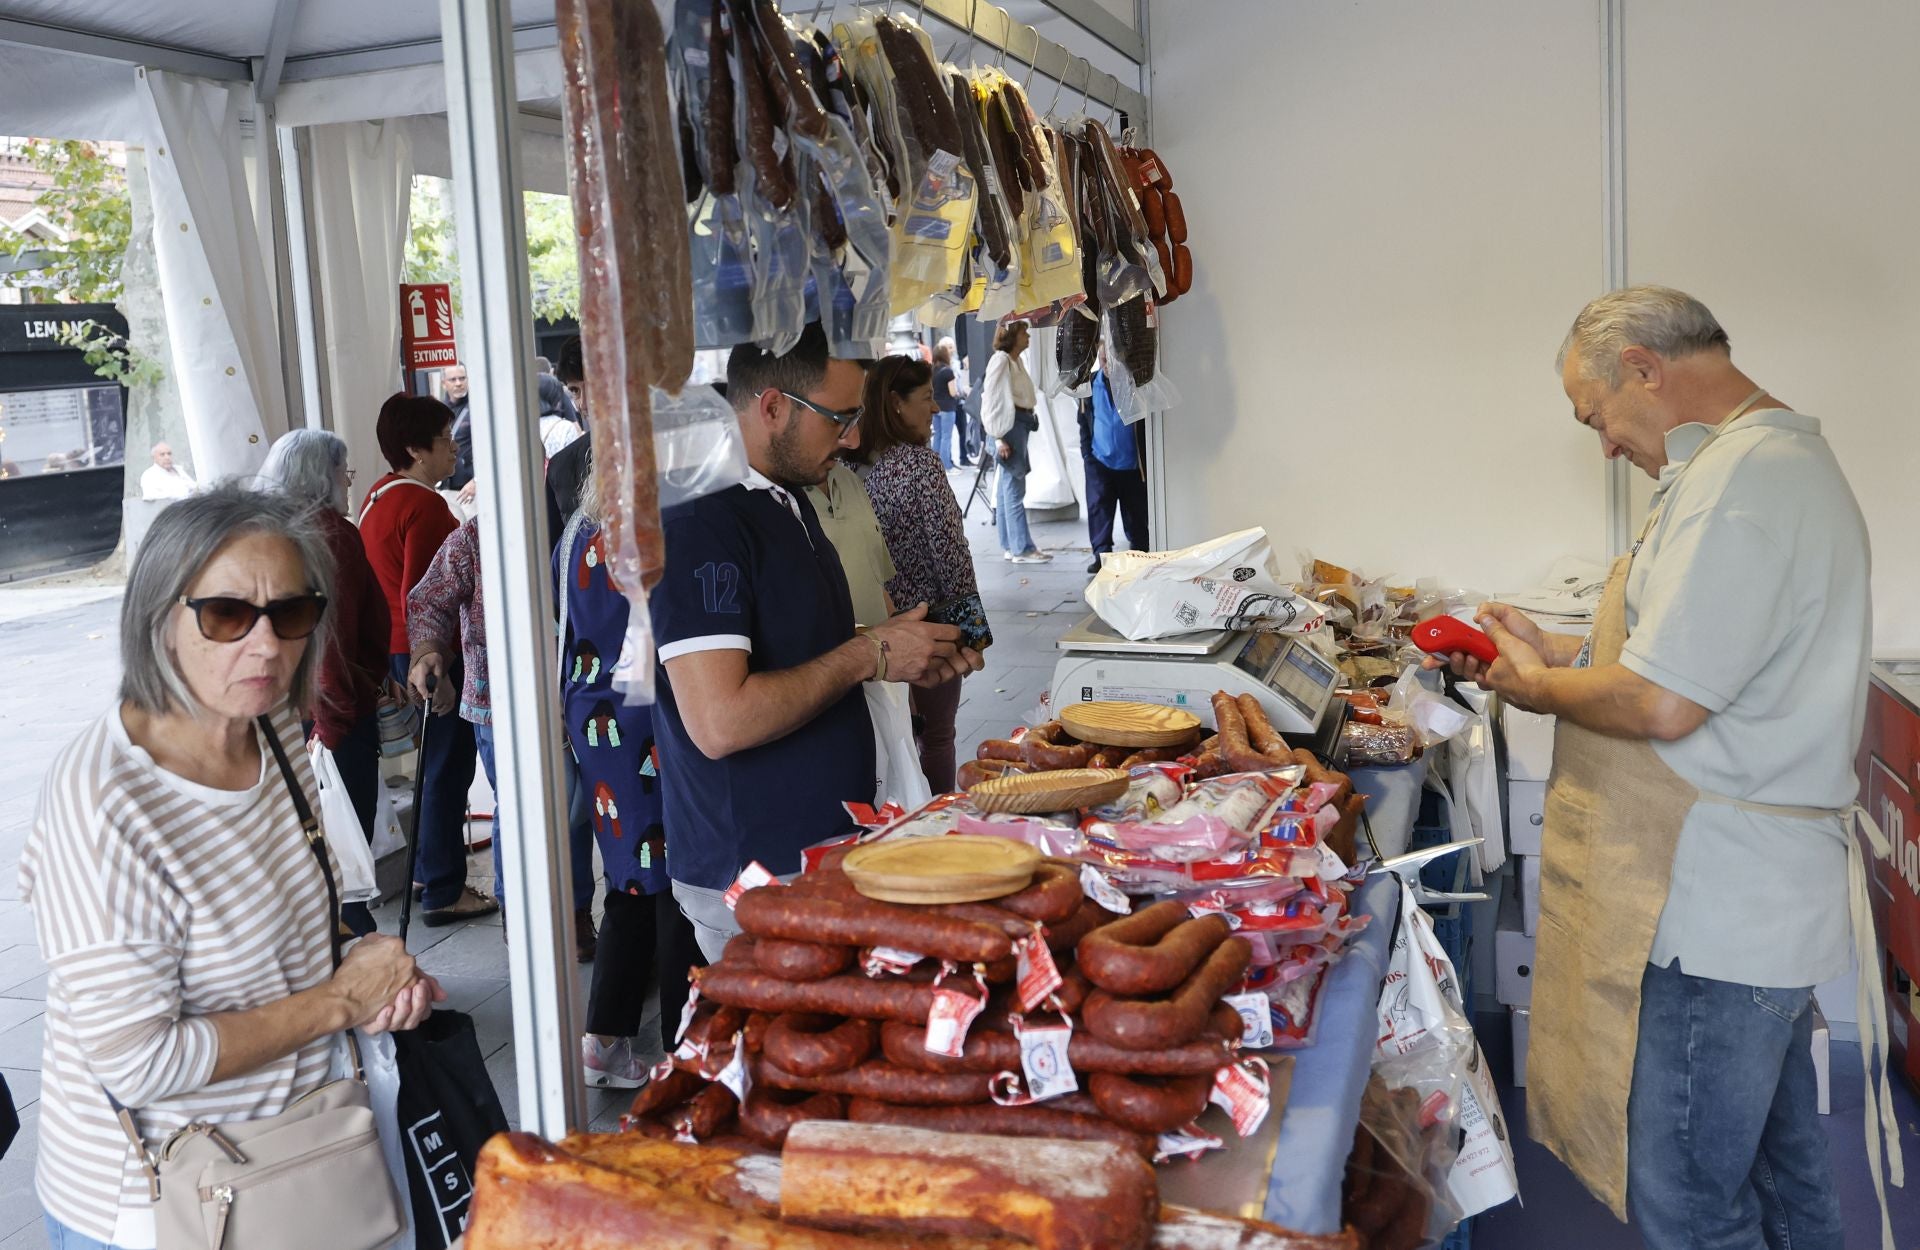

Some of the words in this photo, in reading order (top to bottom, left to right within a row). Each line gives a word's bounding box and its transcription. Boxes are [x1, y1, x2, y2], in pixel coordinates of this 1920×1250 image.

[413, 348, 455, 363] EXTINTOR
[694, 561, 741, 614] 12
[422, 1131, 443, 1153] M
[444, 1172, 459, 1191] S
